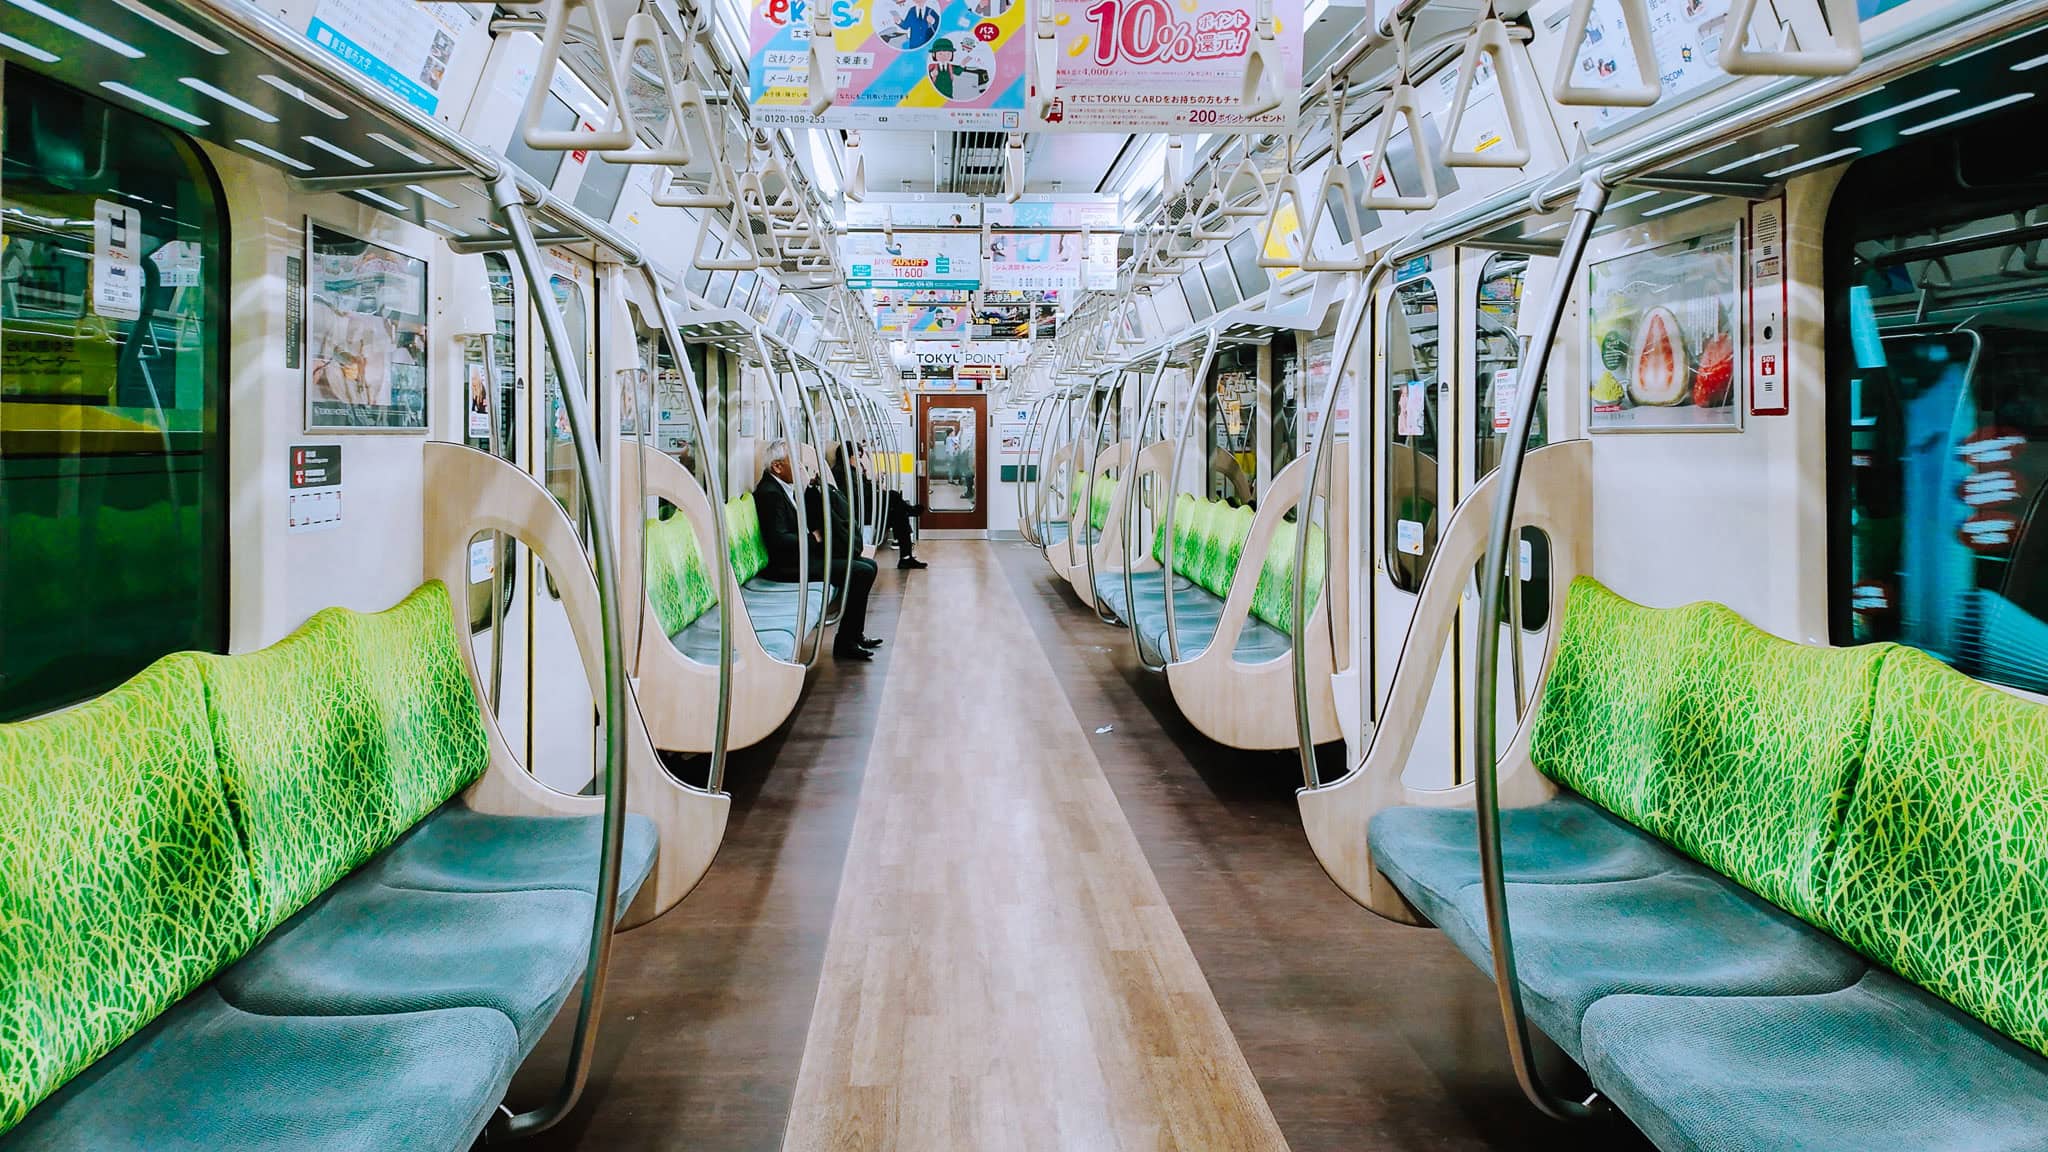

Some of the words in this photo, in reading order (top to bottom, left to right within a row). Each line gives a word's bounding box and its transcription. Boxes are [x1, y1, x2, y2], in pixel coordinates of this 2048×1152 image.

[1200, 13, 1244, 29] ポイント
[979, 26, 995, 35] バス
[1086, 0, 1192, 66] 10%
[1196, 31, 1244, 53] 還元!
[765, 114, 825, 124] 0120-109-253
[894, 257, 926, 266] 20%OFF
[916, 353, 960, 364] TOKYU
[965, 353, 1004, 364] POINT
